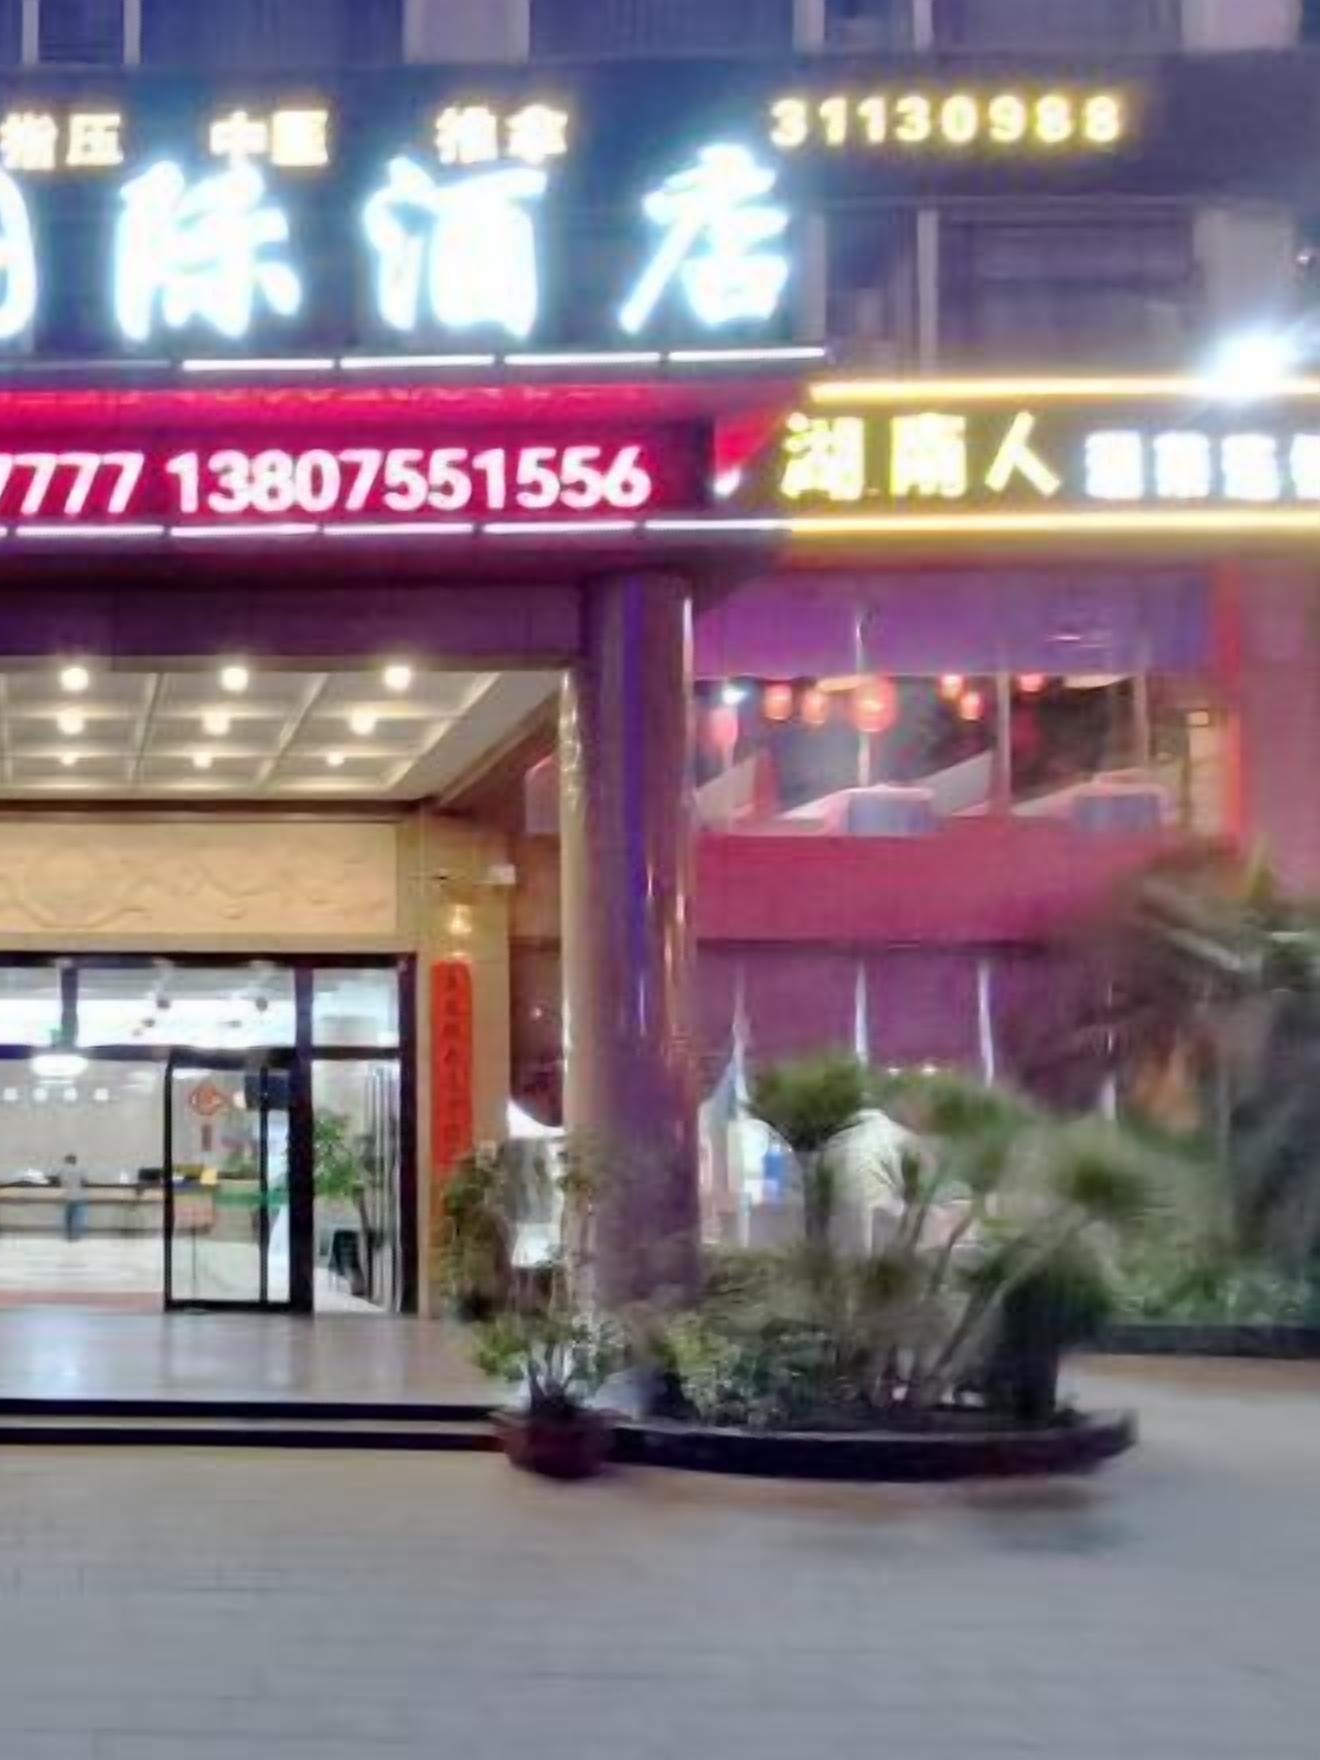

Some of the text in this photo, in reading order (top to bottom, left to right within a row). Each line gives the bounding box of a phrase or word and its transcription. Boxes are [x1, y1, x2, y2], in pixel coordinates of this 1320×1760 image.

[770, 94, 1123, 148] 31130988
[166, 446, 653, 516] 13807551556
[782, 410, 1061, 501] 湖南人
